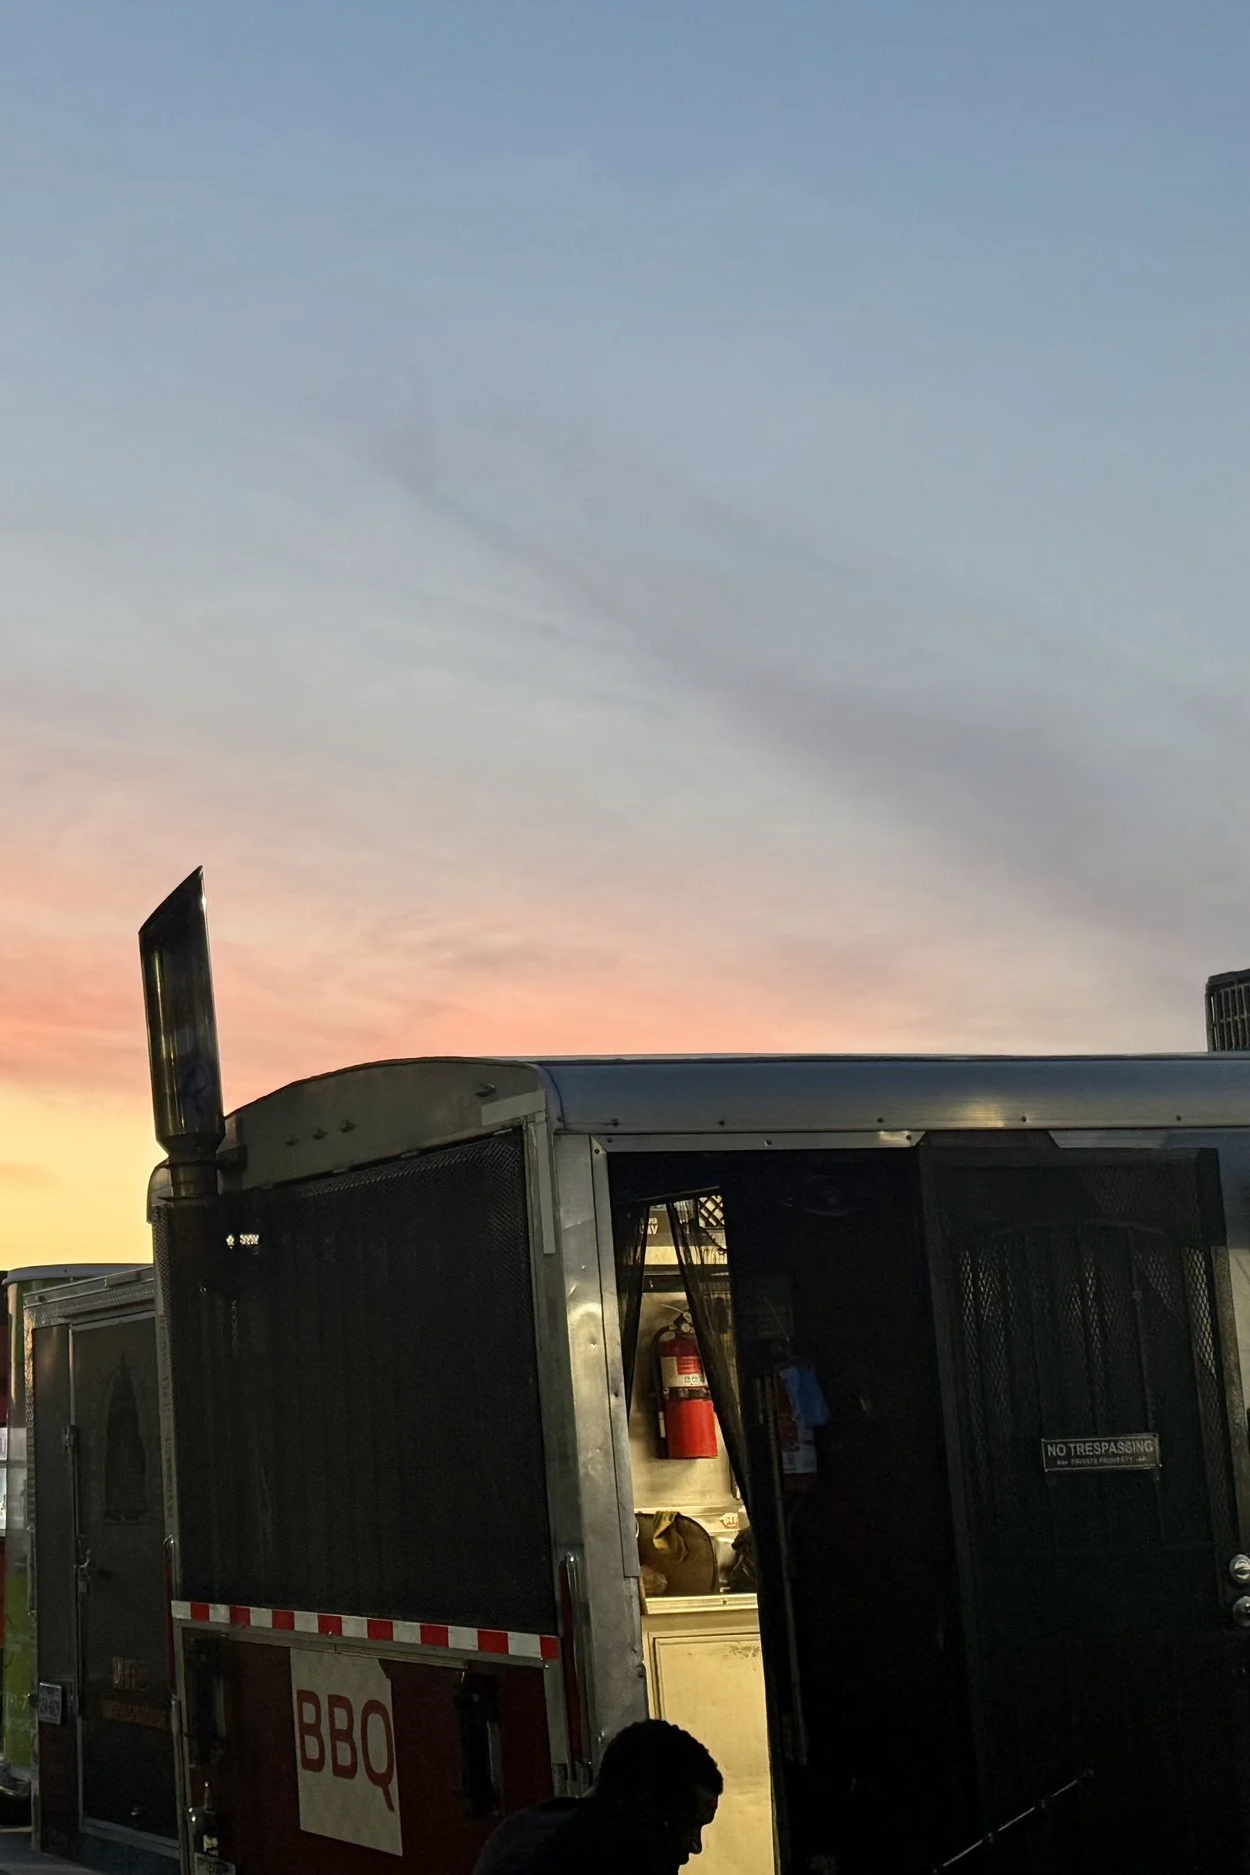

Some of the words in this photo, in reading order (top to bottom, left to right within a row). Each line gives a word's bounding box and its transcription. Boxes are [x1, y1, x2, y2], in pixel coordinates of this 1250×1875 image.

[1047, 1443, 1067, 1457] NO
[1068, 1440, 1154, 1456] TRESPASSING
[297, 1689, 395, 1812] BBQ
